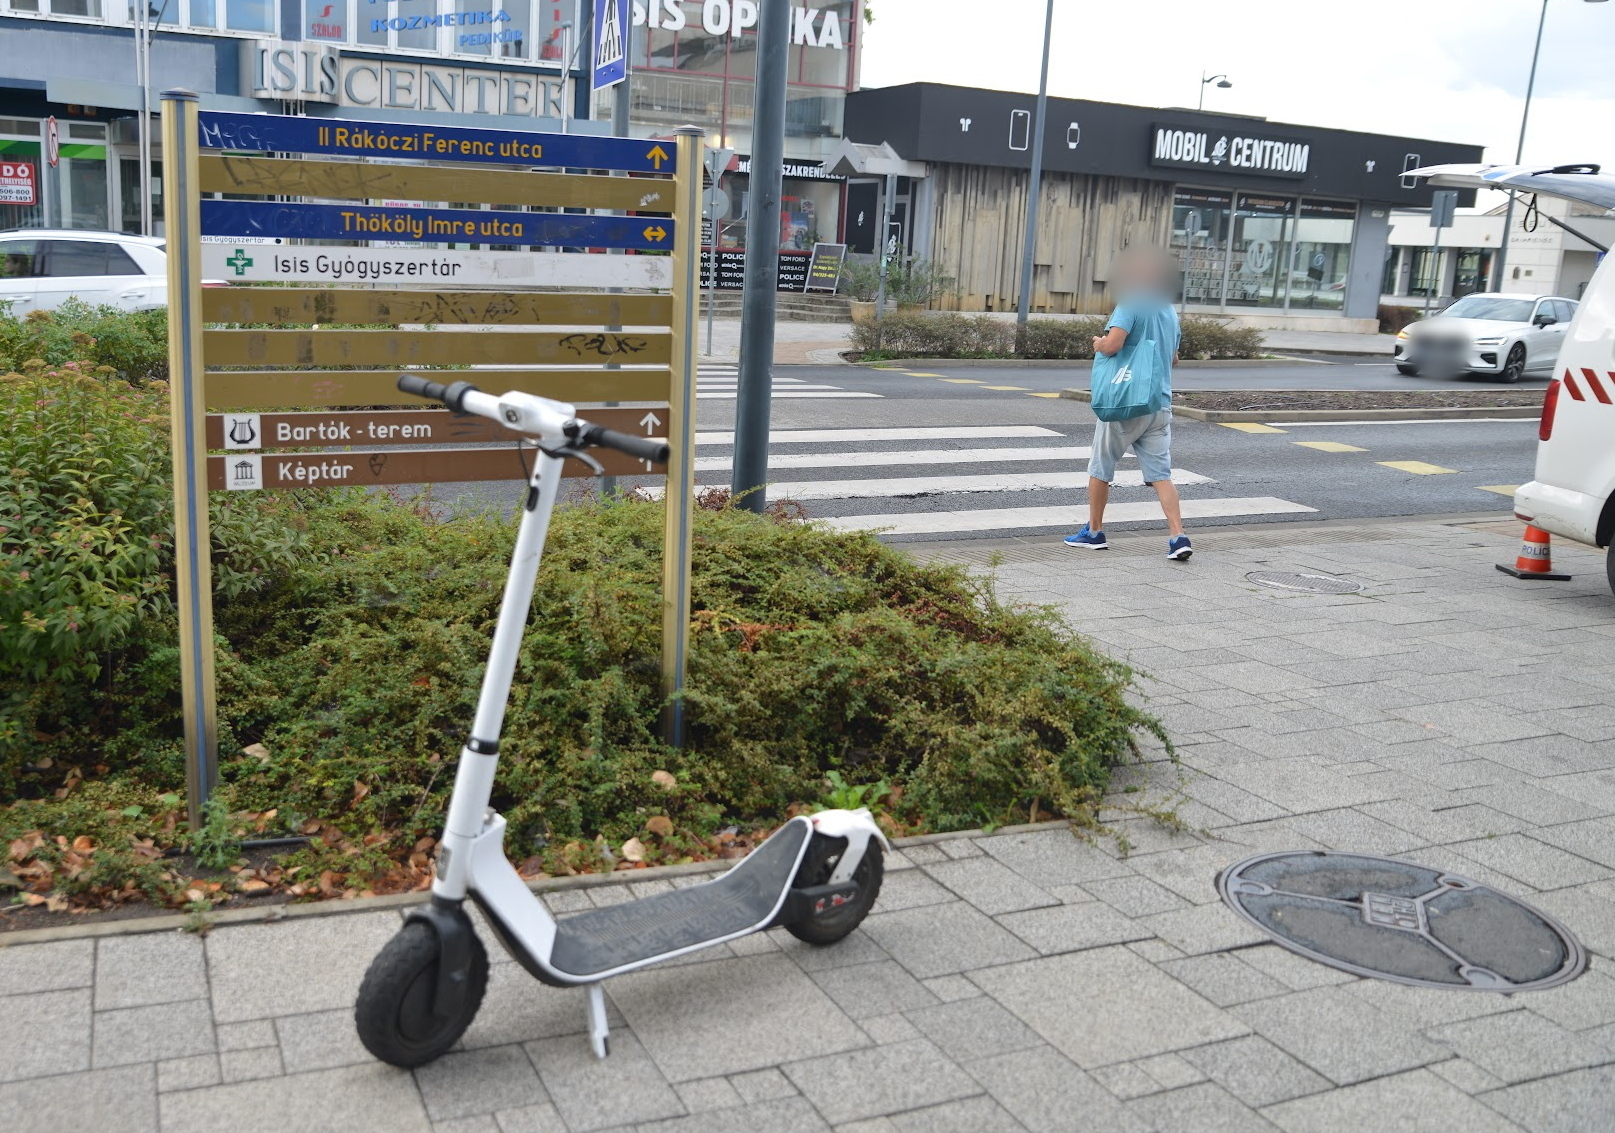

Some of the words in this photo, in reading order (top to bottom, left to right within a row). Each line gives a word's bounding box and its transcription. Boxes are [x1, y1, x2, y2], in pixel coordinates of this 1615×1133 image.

[371, 9, 511, 32] KOZMETIKA
[702, 0, 843, 49] OPKA
[460, 28, 523, 46] PEDIKÜR
[254, 48, 339, 96] ISIS
[335, 128, 418, 151] Rákóczi
[423, 133, 494, 156] Ferenc
[500, 140, 542, 158] utca
[1155, 128, 1210, 163] MOBIL
[1230, 136, 1310, 173] CENTRUM
[340, 212, 423, 238] Thököly
[428, 215, 476, 235] Imre
[480, 219, 523, 237] utca
[274, 255, 309, 273] Isis
[316, 255, 462, 279] Gyógyszertár
[276, 421, 351, 441] Bartók
[368, 422, 432, 438] terem
[279, 459, 353, 484] Képtár
